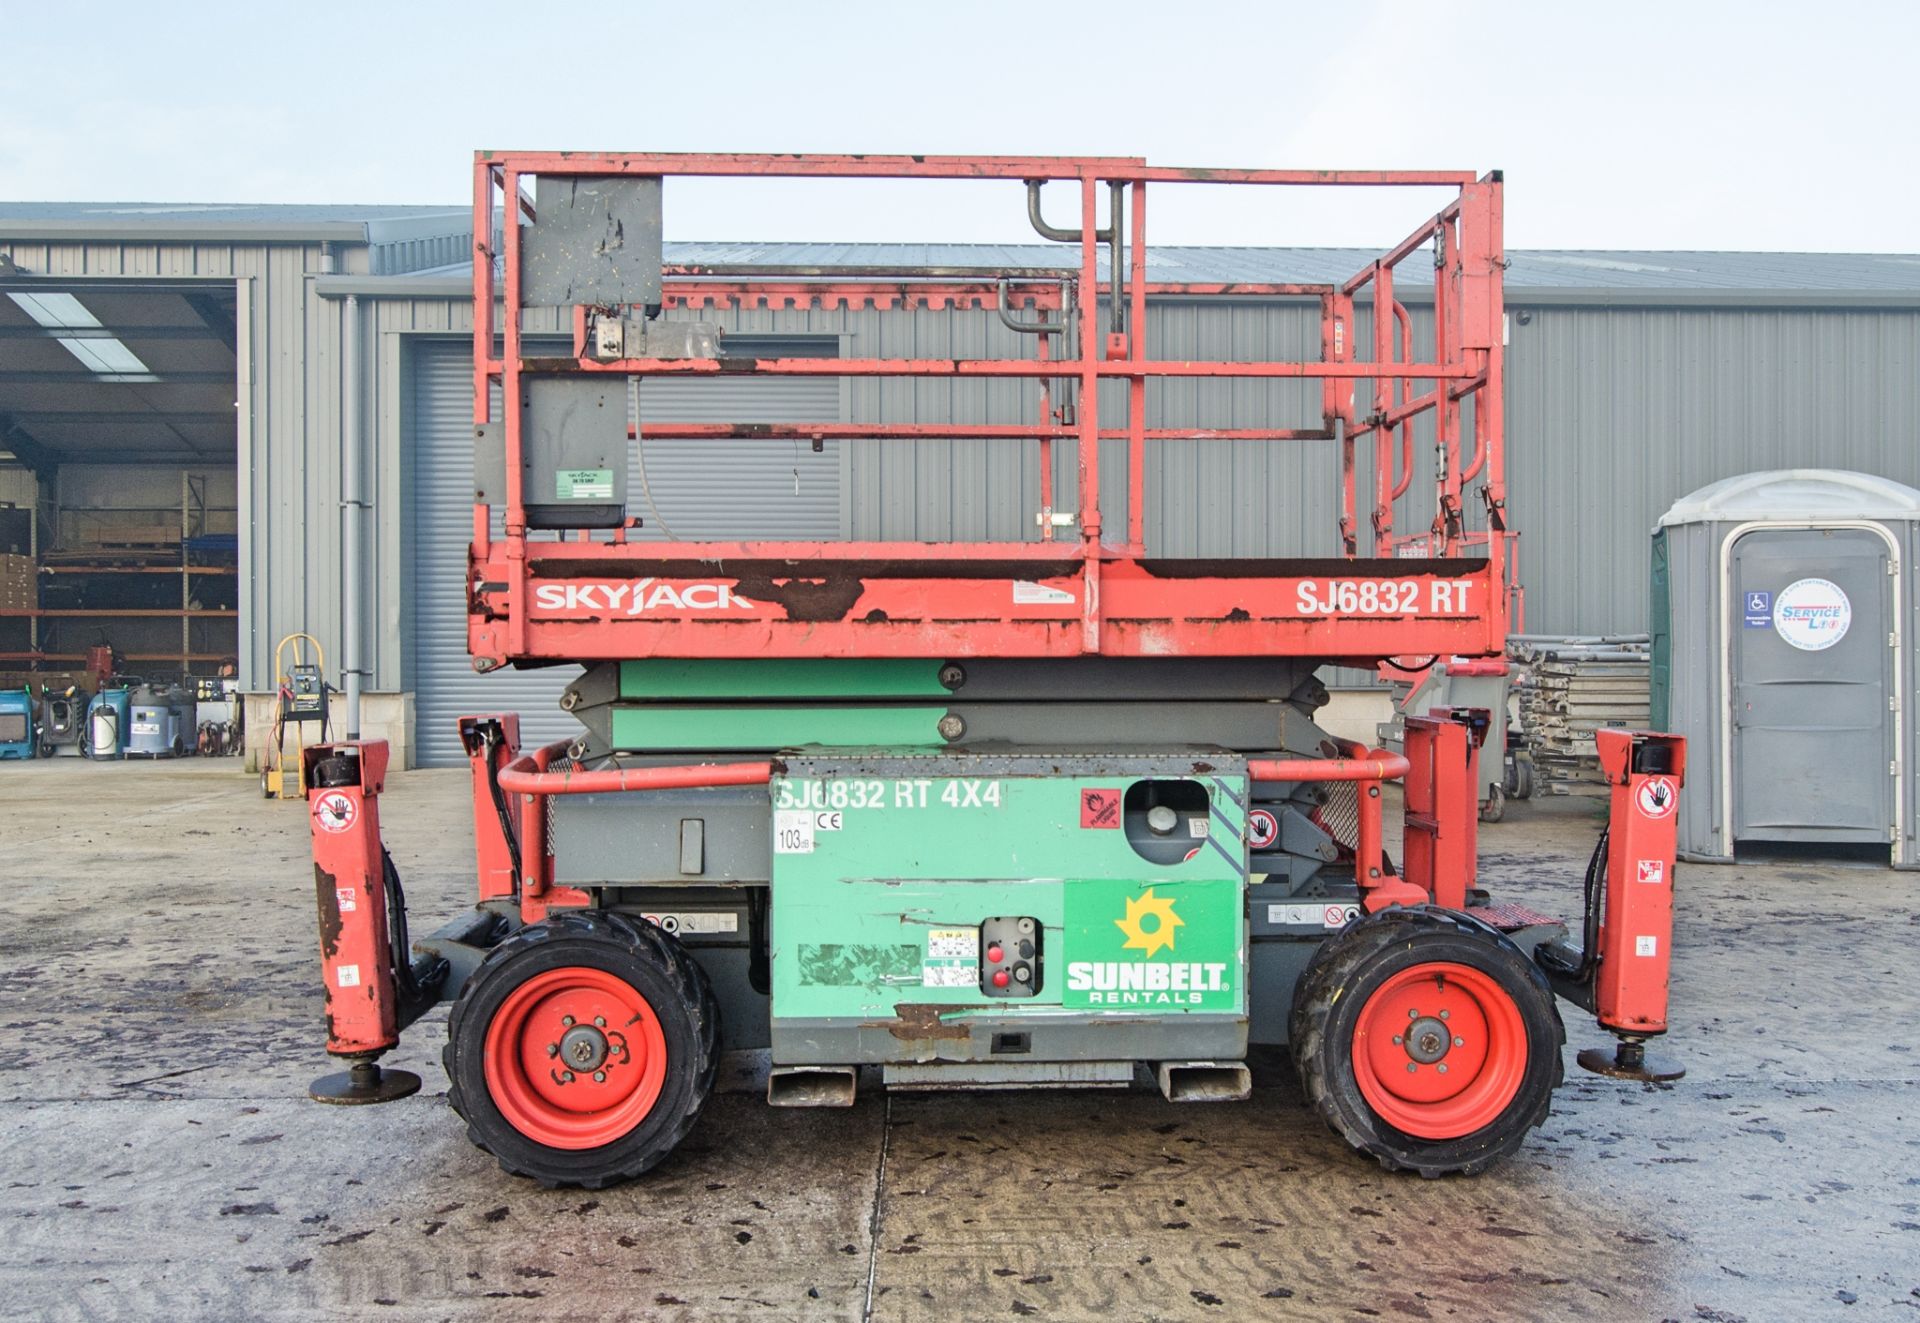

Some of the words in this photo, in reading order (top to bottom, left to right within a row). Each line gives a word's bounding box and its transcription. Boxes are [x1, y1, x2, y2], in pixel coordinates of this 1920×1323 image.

[536, 577, 754, 616] SKYJACK
[1296, 580, 1419, 614] SJ6832
[1431, 580, 1473, 613] RT
[1782, 606, 1841, 618] SERVICE
[776, 780, 885, 809] SJ6832
[895, 780, 932, 808] RT
[941, 780, 1001, 808] 4X4
[779, 829, 801, 849] 103
[1067, 961, 1227, 991] SUNBELT
[1089, 992, 1203, 1003] RENTALS
